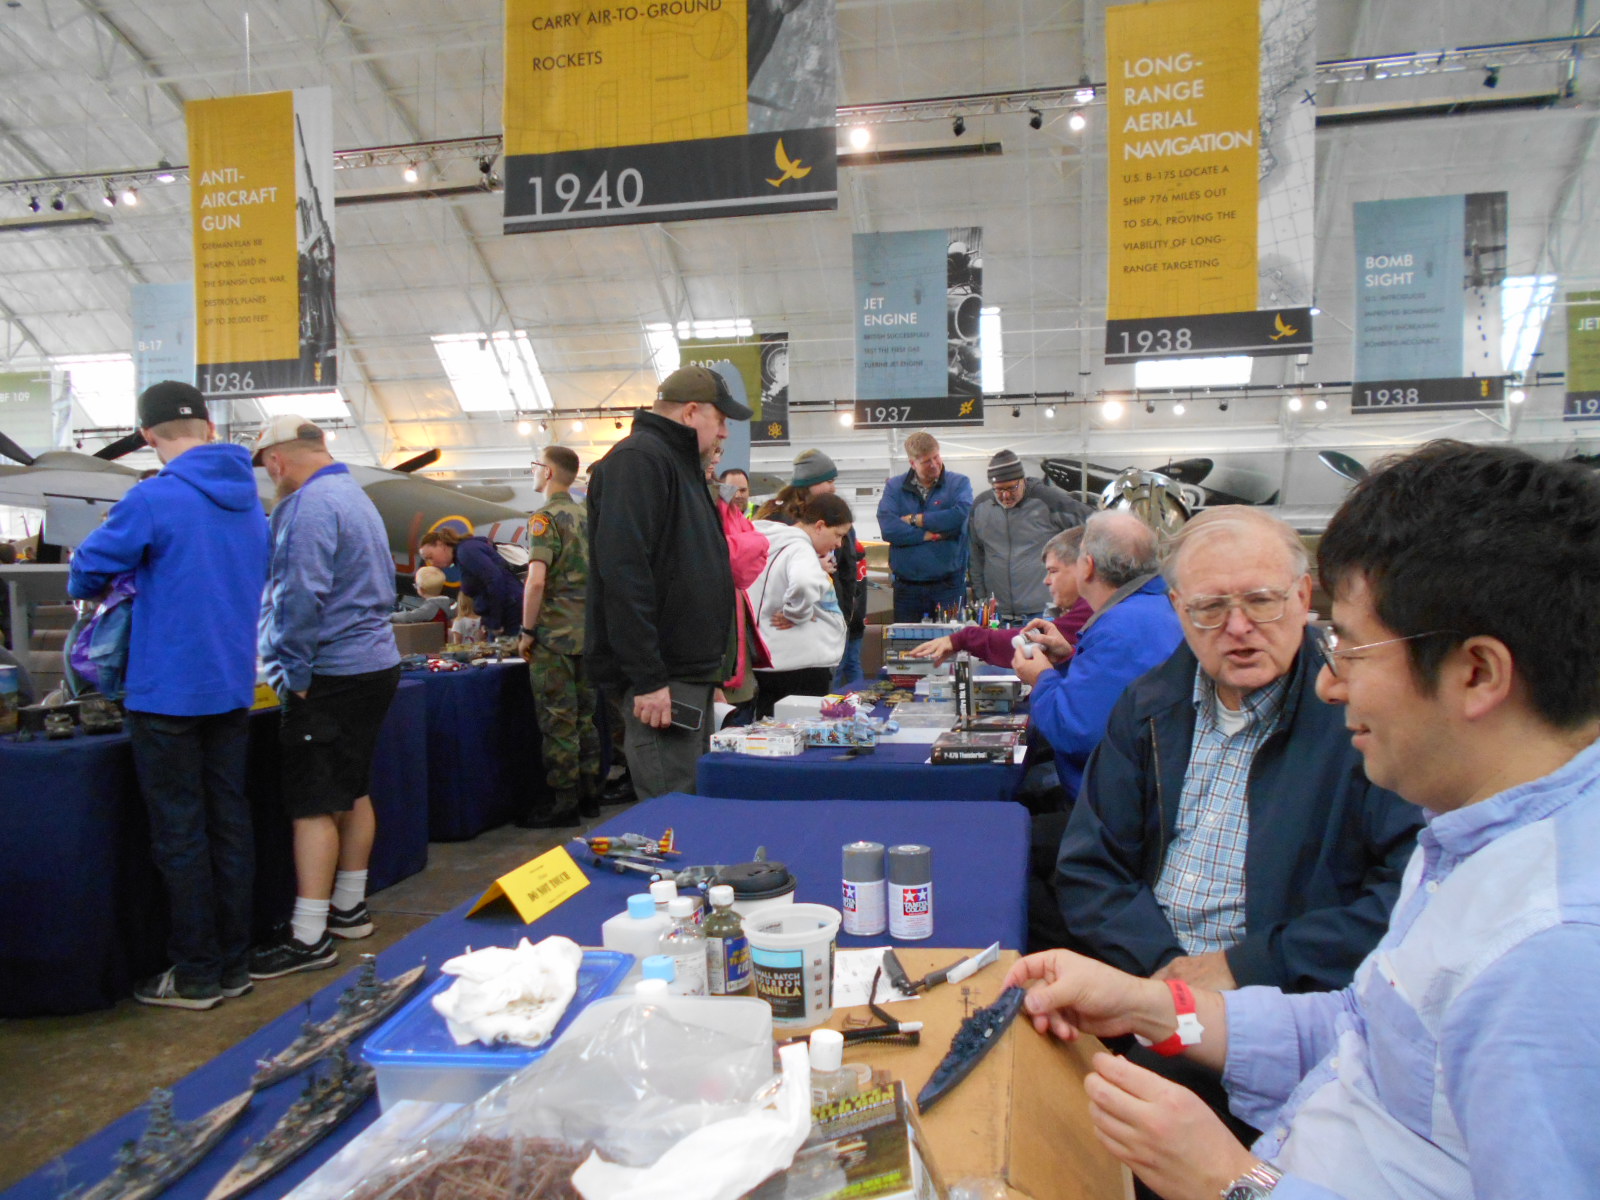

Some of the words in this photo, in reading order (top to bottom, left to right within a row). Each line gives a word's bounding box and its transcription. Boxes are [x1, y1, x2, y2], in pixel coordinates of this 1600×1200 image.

[532, 13, 581, 31] CARRY
[533, 51, 603, 71] ROCKETS
[1124, 52, 1204, 78] LONG-
[1124, 79, 1204, 106] RANGE
[1123, 109, 1198, 133] AERIAL
[1124, 129, 1253, 160] NAVIGATION
[200, 167, 246, 186] ANTI-
[1123, 175, 1142, 184] U.S.
[1179, 166, 1219, 178] LOCATE
[1221, 165, 1230, 173] A
[201, 187, 278, 209] AIRCRAFT
[529, 167, 644, 215] 1940
[1123, 196, 1146, 206] SHIP
[1149, 194, 1169, 204] 776
[1171, 190, 1201, 202] MILES
[1203, 187, 1227, 199] OUT
[202, 213, 241, 232] GUN
[1123, 220, 1137, 228] TO
[1166, 212, 1213, 225] PROVING
[1217, 210, 1237, 219] THE
[1123, 240, 1168, 251] VIABILITY
[1172, 238, 1187, 248] OF
[1123, 263, 1158, 274] RANGE
[1162, 258, 1220, 271] TARGETING
[1365, 254, 1413, 269] BOMB
[1365, 271, 1415, 287] SIGHT
[864, 297, 885, 310] JET
[864, 312, 918, 327] ENGINE
[138, 340, 162, 351] B-17
[1119, 328, 1193, 354] 1938
[690, 359, 730, 369] RAD
[203, 371, 255, 393] 1936
[13, 391, 30, 402] 109
[1364, 388, 1420, 407] 1938
[865, 406, 911, 422] 1937
[773, 972, 800, 980] BATCH
[758, 982, 802, 997] VANILLA
